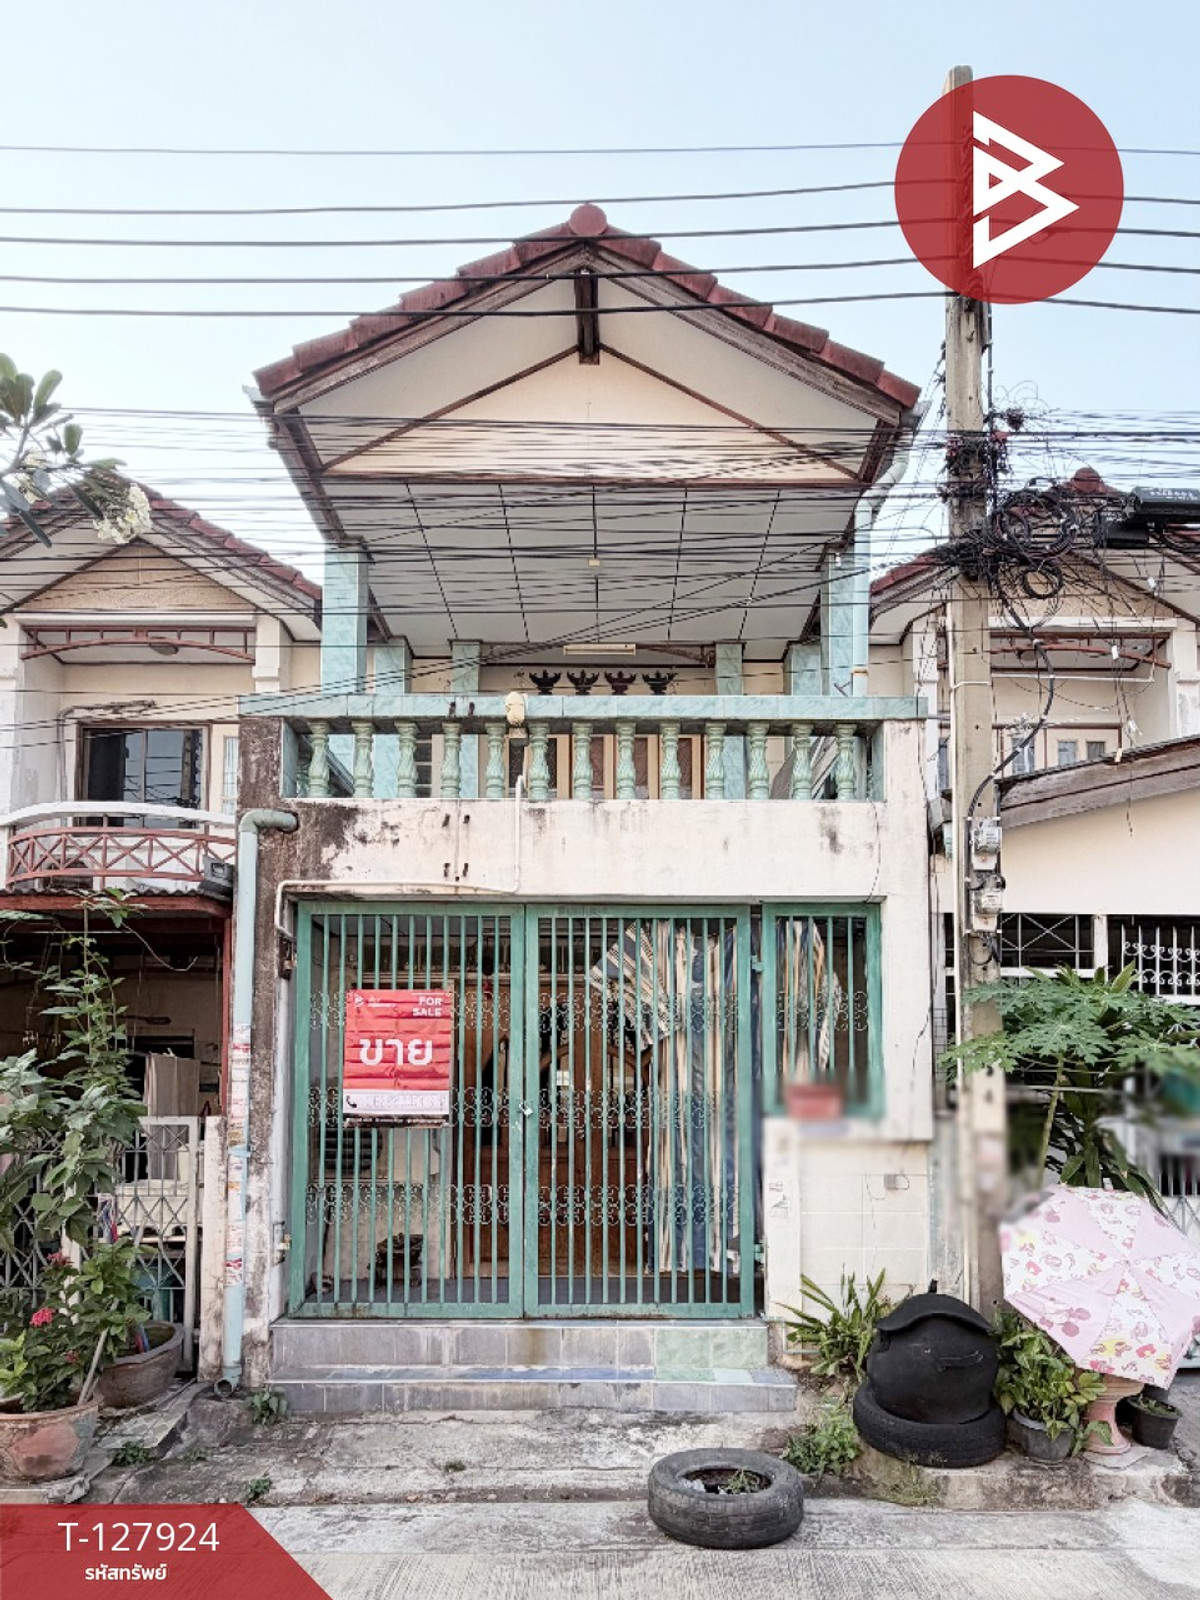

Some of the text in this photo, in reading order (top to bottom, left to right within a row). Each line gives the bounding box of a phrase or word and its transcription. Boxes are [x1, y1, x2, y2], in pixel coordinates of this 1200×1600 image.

[419, 996, 443, 1006] FOR
[412, 1008, 443, 1017] SALE
[360, 1038, 433, 1067] ขาย
